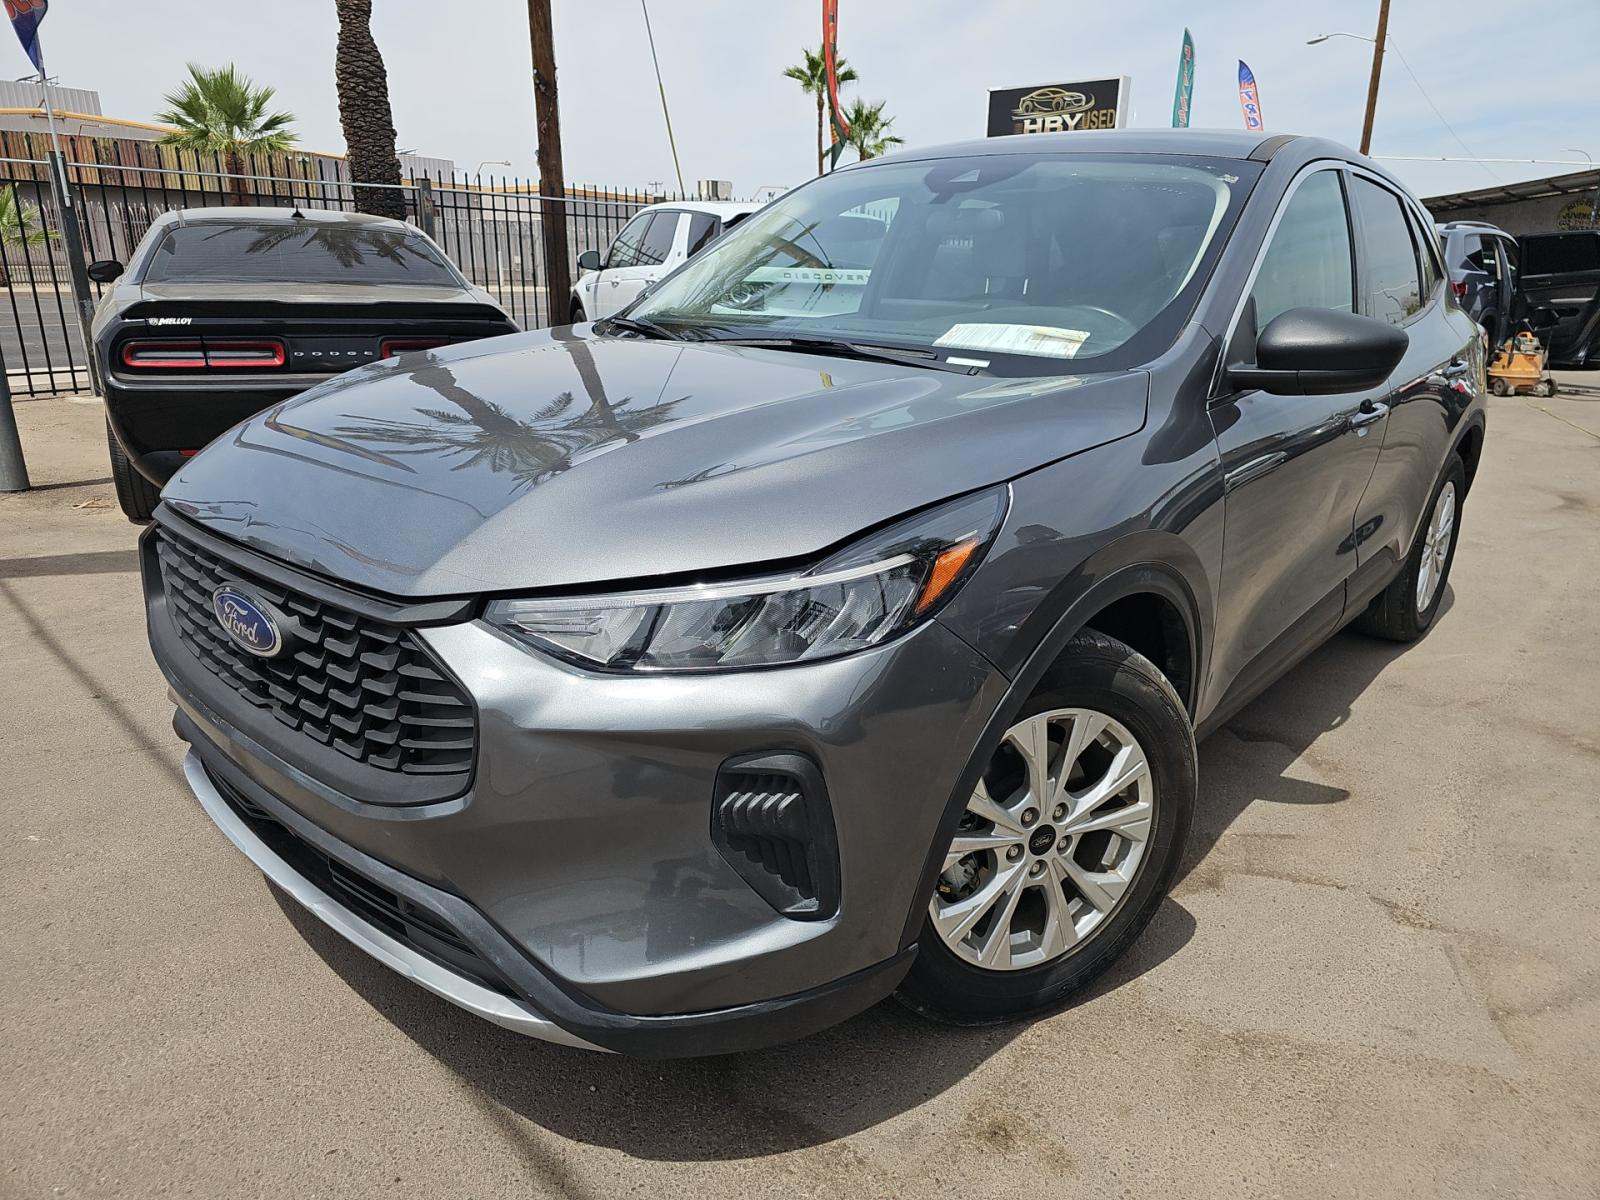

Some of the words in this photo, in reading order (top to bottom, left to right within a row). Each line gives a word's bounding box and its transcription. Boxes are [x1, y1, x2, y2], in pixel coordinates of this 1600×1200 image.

[1082, 109, 1116, 129] USED
[784, 272, 869, 280] DISCOVER
[223, 600, 258, 643] Ford
